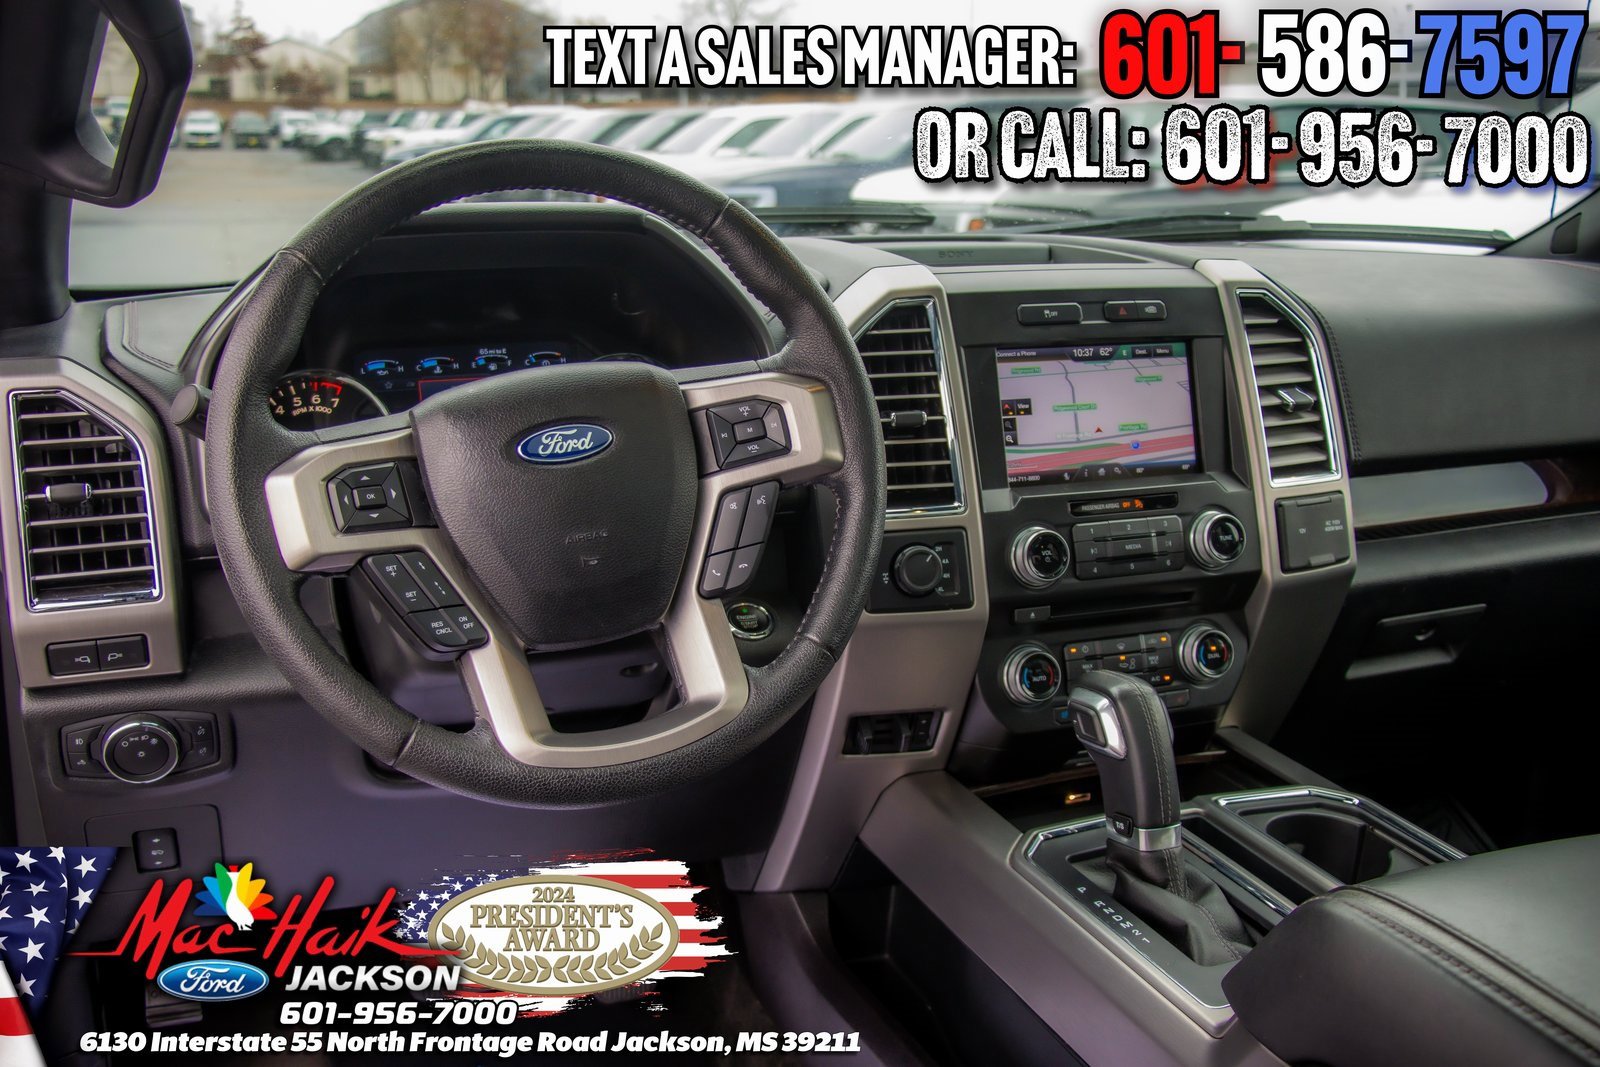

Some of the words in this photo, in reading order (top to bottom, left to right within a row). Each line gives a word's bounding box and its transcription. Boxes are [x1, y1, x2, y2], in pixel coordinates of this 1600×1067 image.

[1072, 348, 1094, 357] 10:37
[292, 396, 302, 407] 5
[311, 394, 321, 404] 6
[331, 398, 340, 408] 7
[275, 405, 285, 415] 4
[315, 405, 333, 414] 1000
[538, 428, 593, 457] Ford
[405, 590, 417, 598] SET
